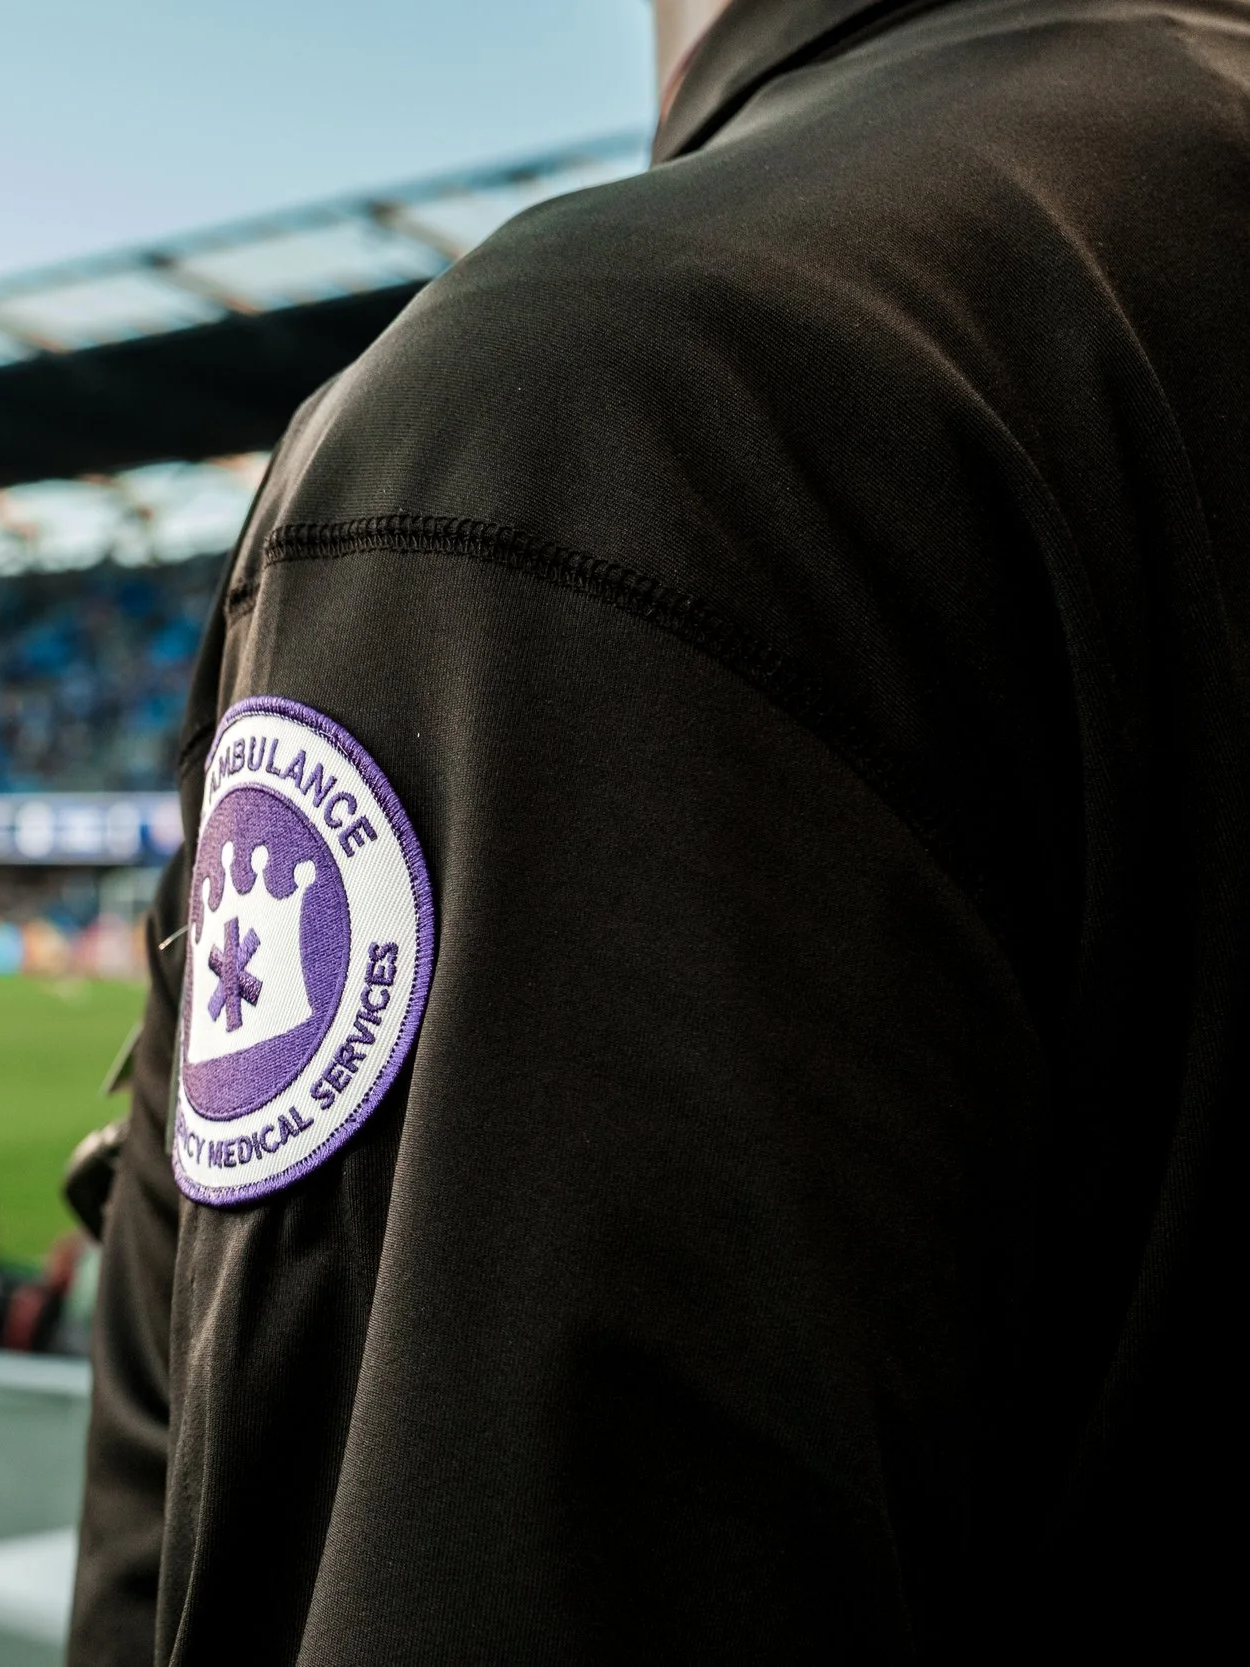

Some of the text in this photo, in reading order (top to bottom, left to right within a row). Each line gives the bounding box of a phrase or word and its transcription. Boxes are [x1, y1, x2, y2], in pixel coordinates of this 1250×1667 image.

[208, 736, 378, 858] AMBULANCE
[208, 1106, 315, 1169] MEDICAL
[310, 941, 399, 1111] SERVICES
